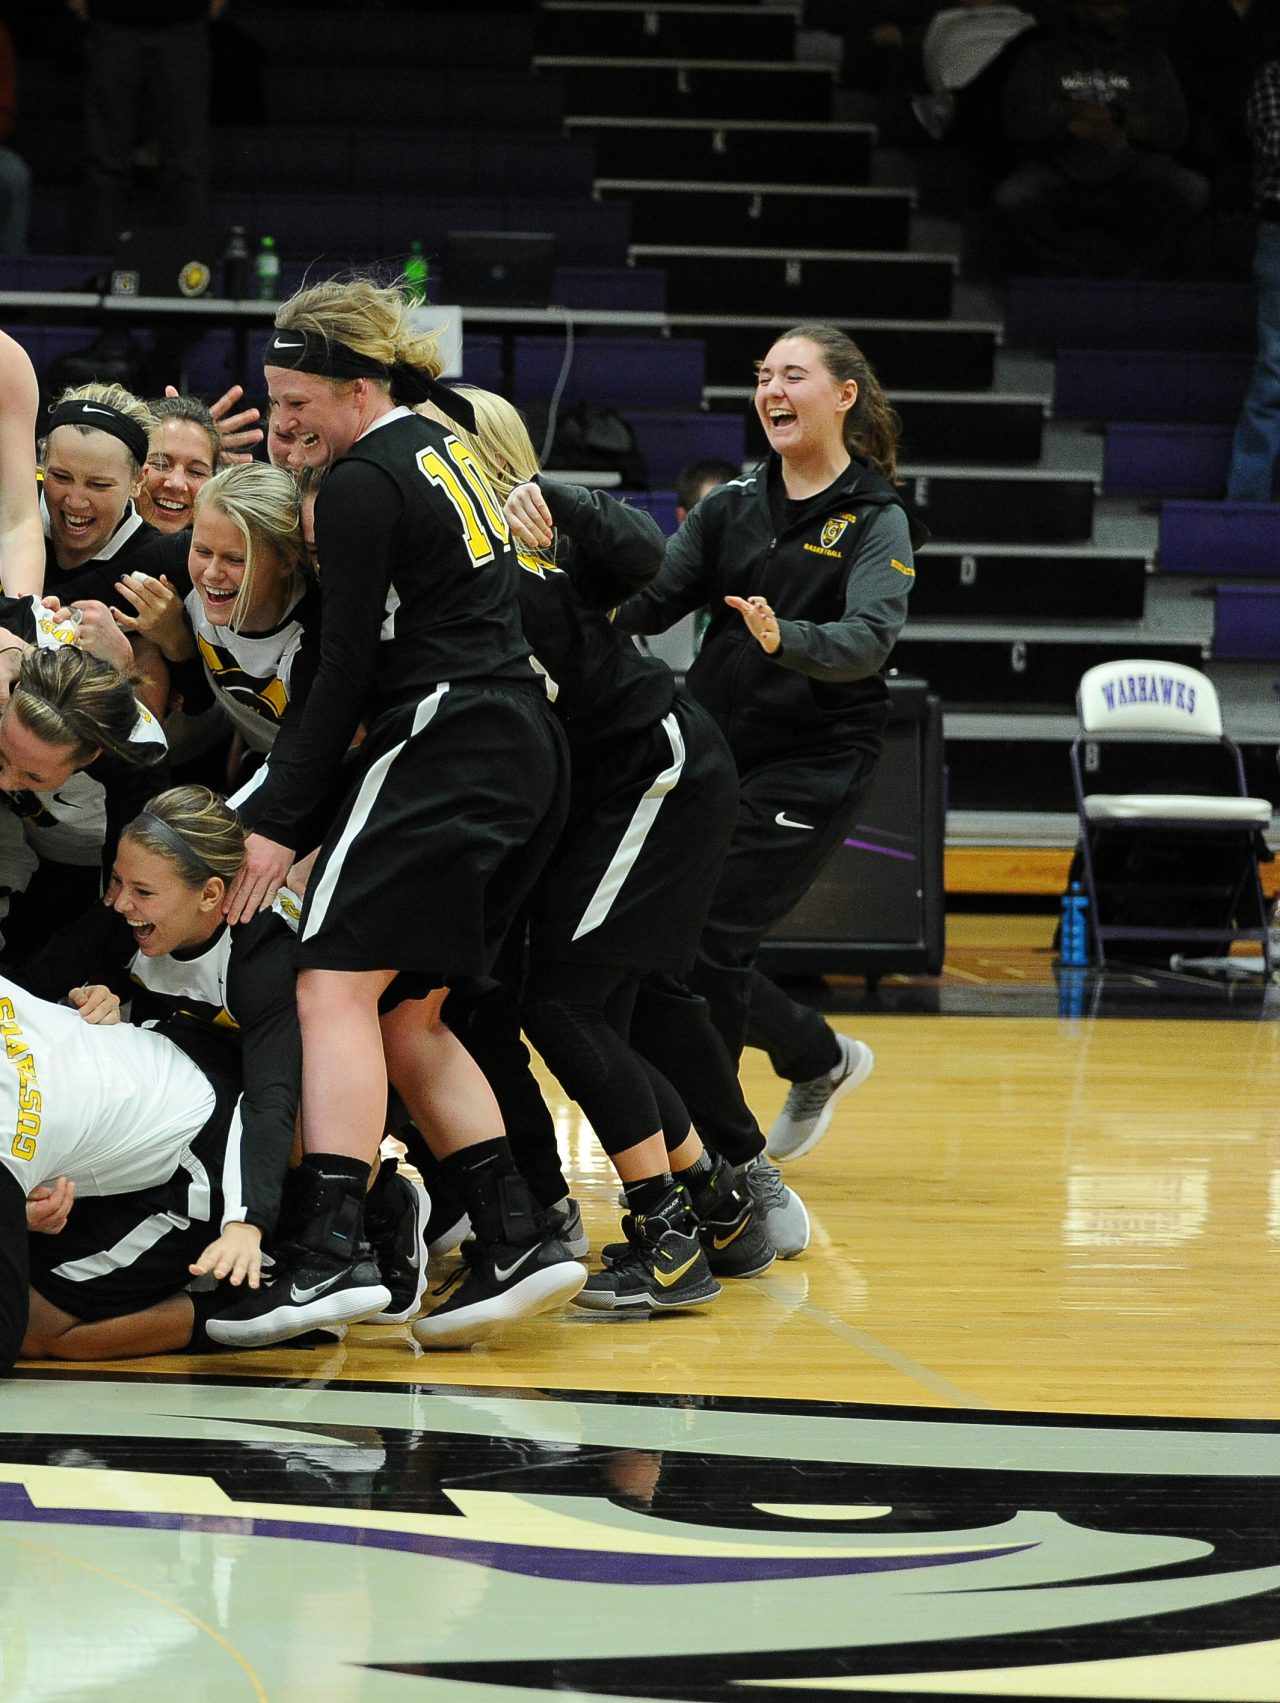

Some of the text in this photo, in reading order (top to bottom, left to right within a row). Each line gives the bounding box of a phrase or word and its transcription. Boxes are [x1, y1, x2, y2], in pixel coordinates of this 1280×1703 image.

[415, 434, 511, 568] 10
[803, 543, 842, 558] BASKETBALL
[1102, 673, 1196, 715] WARHAWKS
